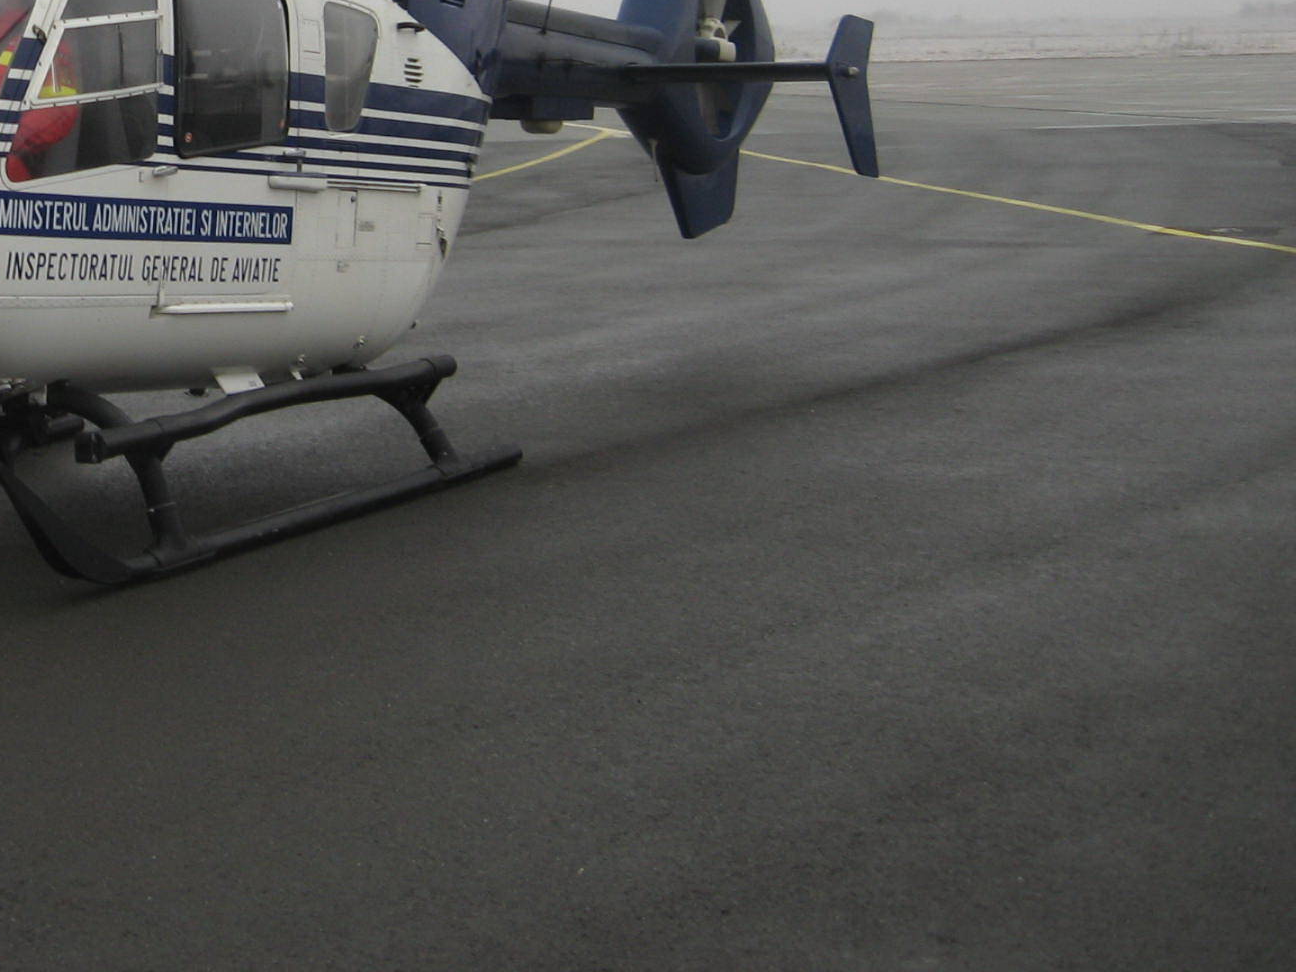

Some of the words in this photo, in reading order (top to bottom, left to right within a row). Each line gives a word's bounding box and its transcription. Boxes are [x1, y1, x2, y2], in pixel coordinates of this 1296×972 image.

[92, 203, 197, 236] ADMINISTRATIEI
[200, 208, 213, 237] SI
[215, 209, 289, 239] INTERNELOR
[5, 251, 135, 281] INSPECTORATUL
[141, 254, 204, 282] GENERAL
[210, 256, 229, 283] DE
[232, 257, 281, 283] AVIATIE
